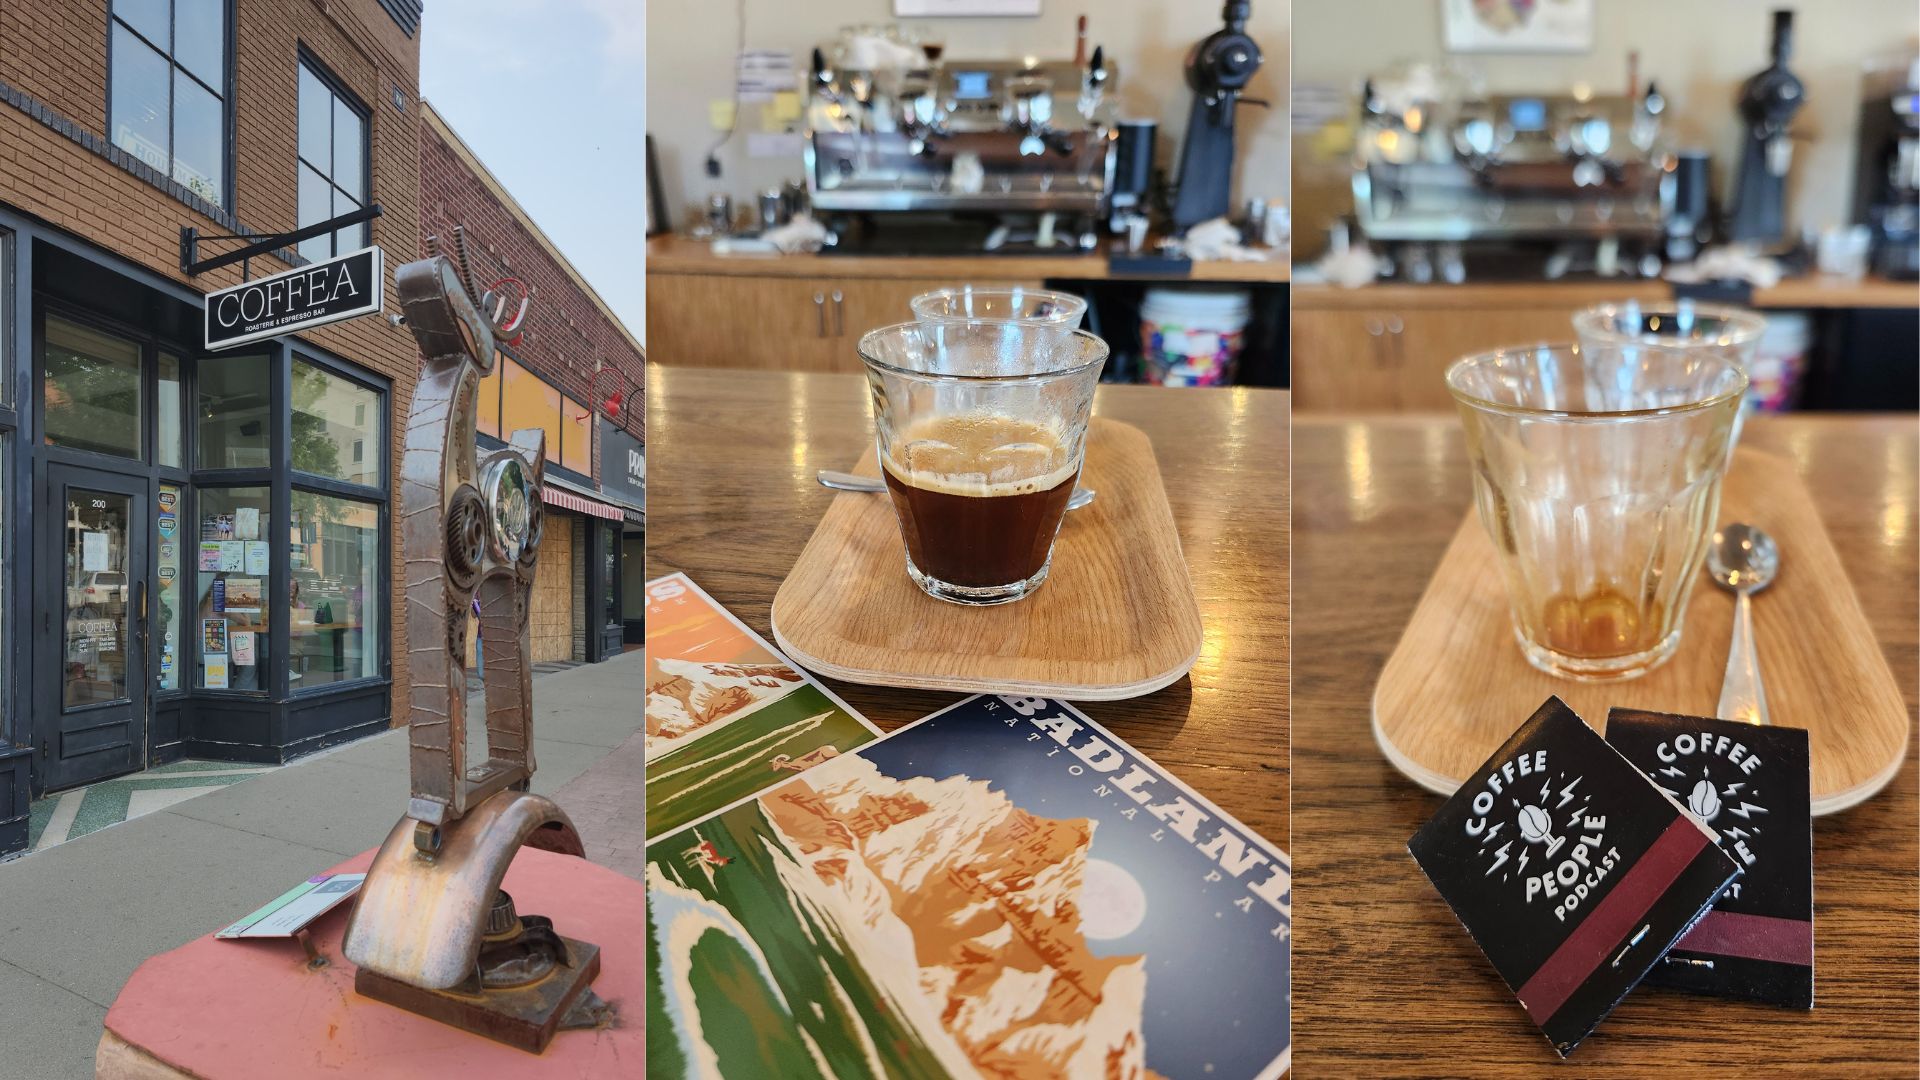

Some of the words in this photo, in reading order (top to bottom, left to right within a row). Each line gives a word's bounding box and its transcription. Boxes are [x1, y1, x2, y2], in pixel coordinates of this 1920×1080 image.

[217, 262, 359, 328] COFFEA
[244, 320, 275, 333] ROASTERIE
[281, 310, 312, 324] ESPRESSO
[312, 307, 326, 317] BAR
[92, 499, 106, 509] 200
[983, 701, 1165, 842] NATIONAL
[1656, 732, 1762, 775] COFFEE
[1465, 750, 1547, 836] COFFEE
[1525, 815, 1607, 903] PEOPLE
[1554, 846, 1621, 921] PODCAST
